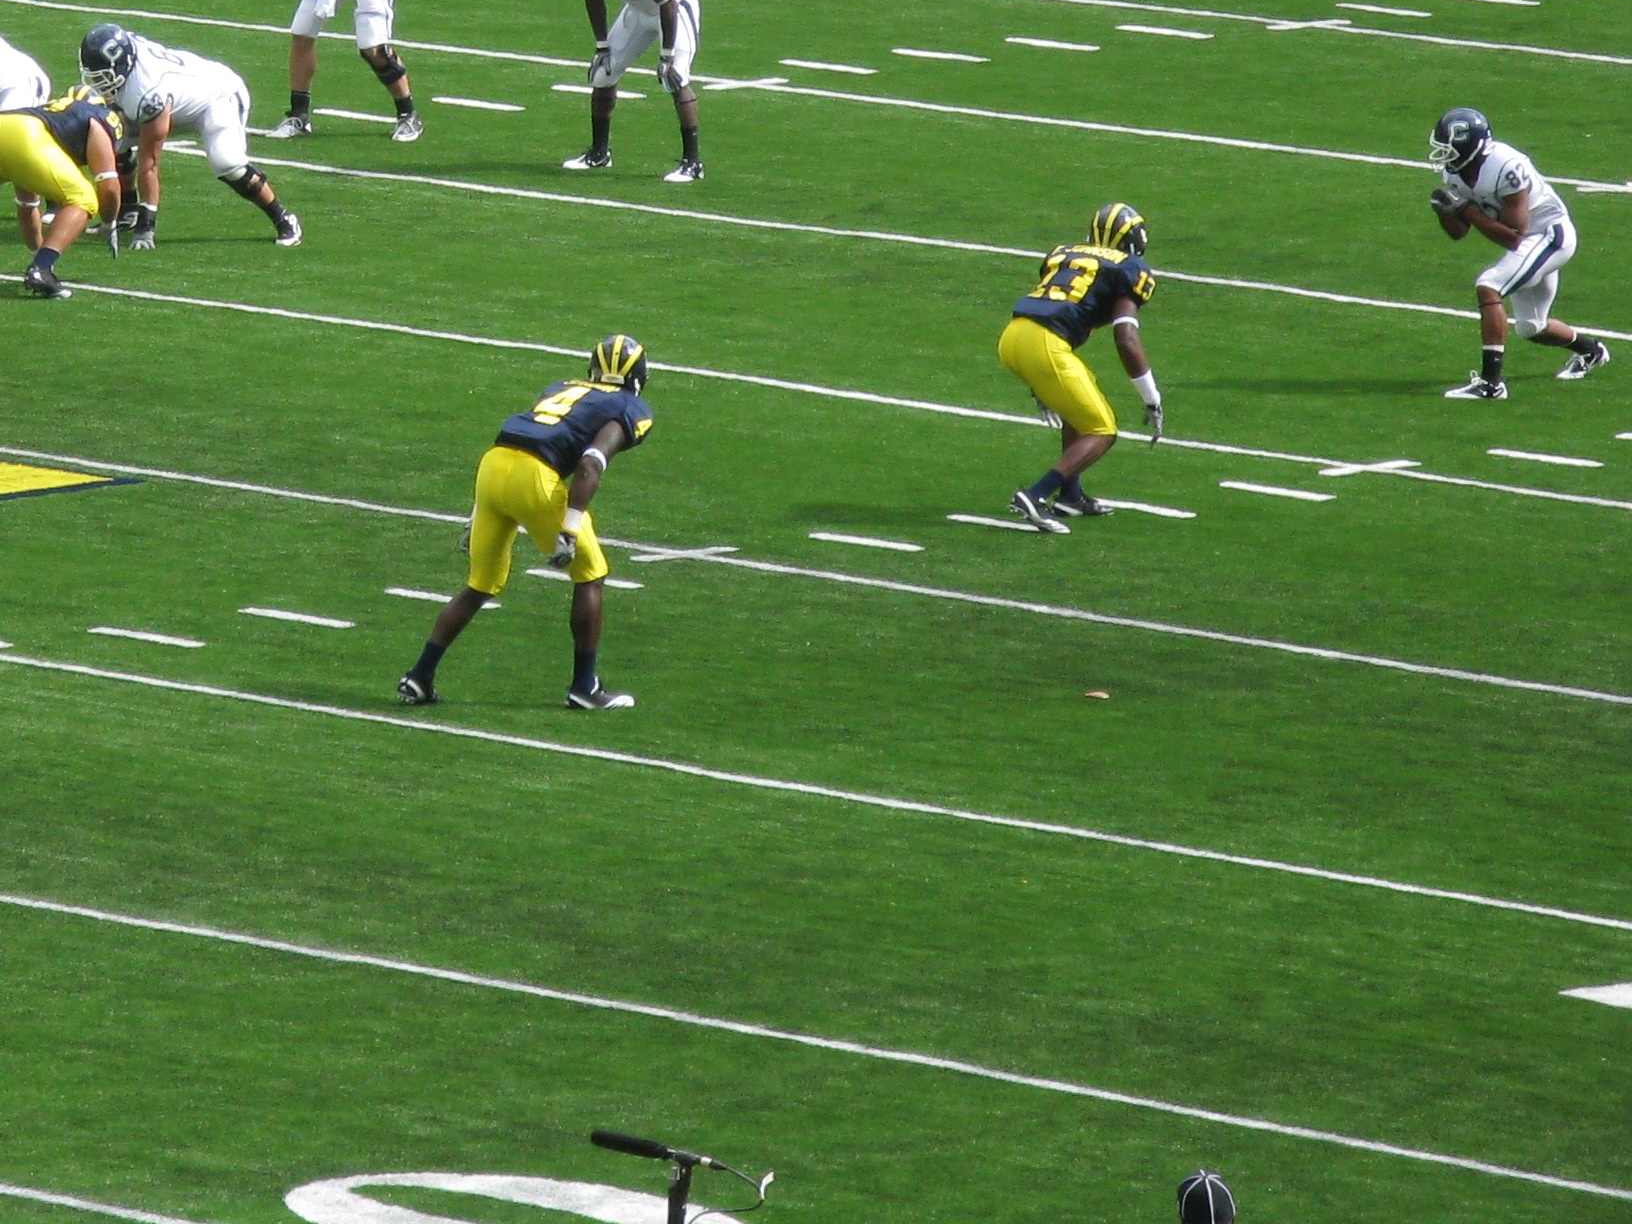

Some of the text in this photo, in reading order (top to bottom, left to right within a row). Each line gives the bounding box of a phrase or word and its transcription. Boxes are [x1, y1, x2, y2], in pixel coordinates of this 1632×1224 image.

[98, 37, 125, 63] C
[1447, 120, 1470, 146] C
[1504, 162, 1530, 190] 82
[1027, 256, 1101, 305] 13
[1133, 272, 1158, 303] 13
[532, 386, 593, 427] 4
[633, 418, 654, 440] 4
